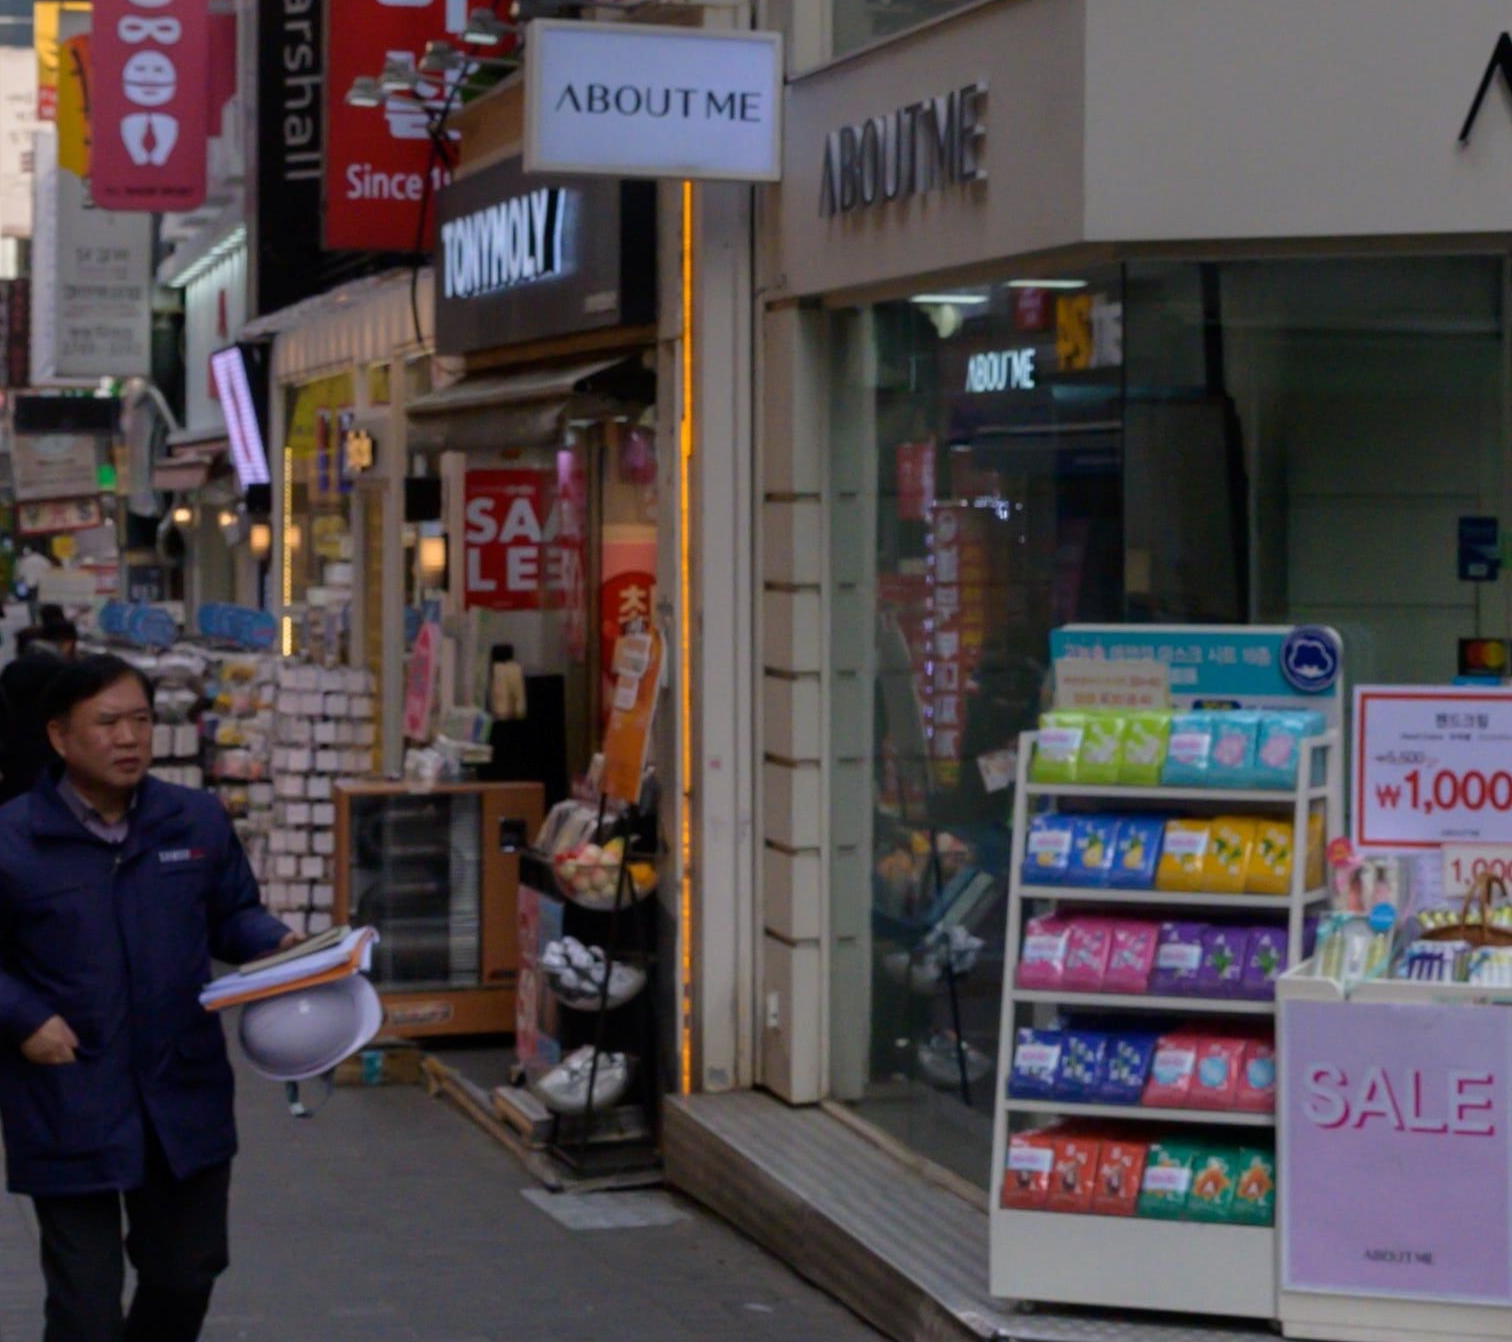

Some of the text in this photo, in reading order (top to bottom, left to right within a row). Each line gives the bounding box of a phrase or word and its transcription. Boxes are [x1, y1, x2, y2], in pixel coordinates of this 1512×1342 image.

[555, 83, 762, 124] ABOUT ME
[345, 162, 425, 201] Since
[819, 103, 926, 216] ABOUT
[441, 186, 549, 299] TONYMOLY
[1303, 1062, 1496, 1137] SALE
